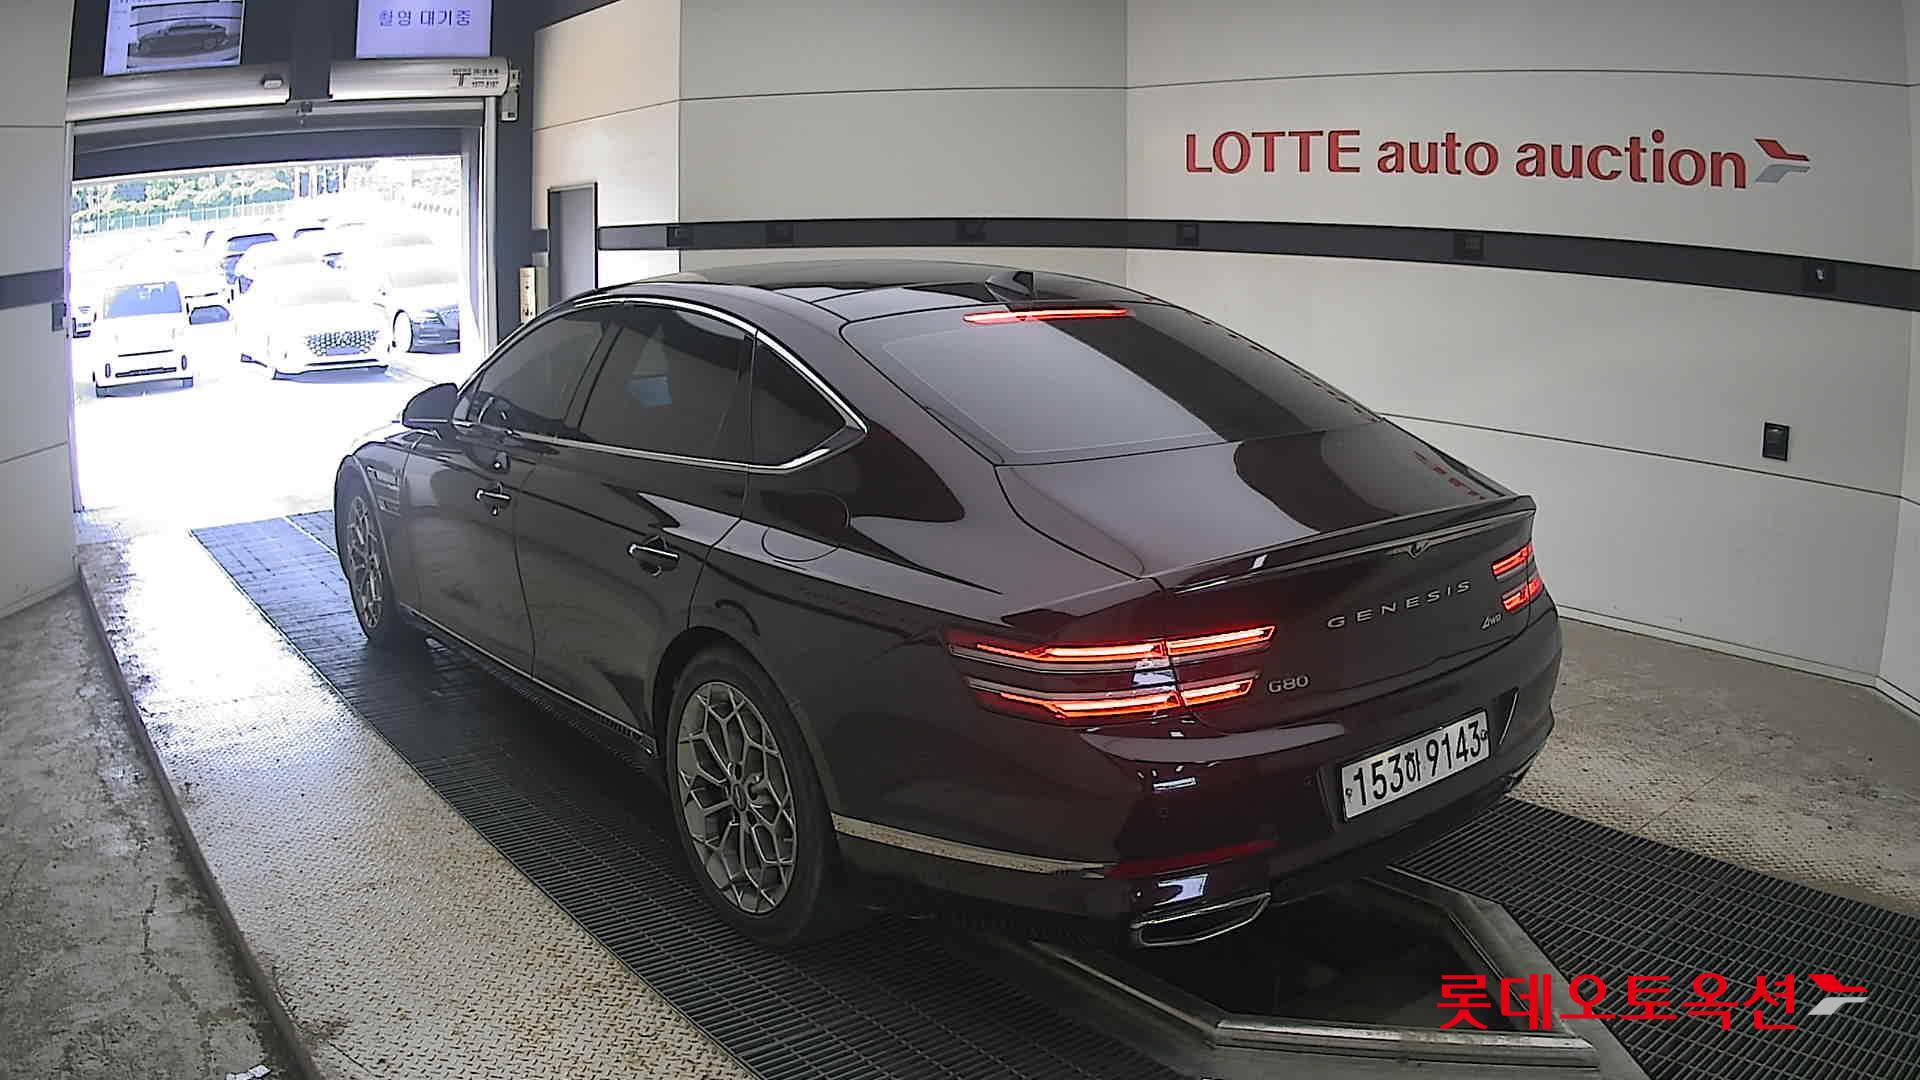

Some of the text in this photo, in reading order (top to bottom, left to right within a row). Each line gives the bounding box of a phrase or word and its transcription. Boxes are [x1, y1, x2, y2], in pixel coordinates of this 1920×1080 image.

[420, 9, 471, 26] 대기중
[1185, 129, 1747, 189] LOTTE auto auction
[1327, 579, 1472, 629] GENESIS
[1268, 675, 1310, 693] G80
[1425, 720, 1482, 777] 9143
